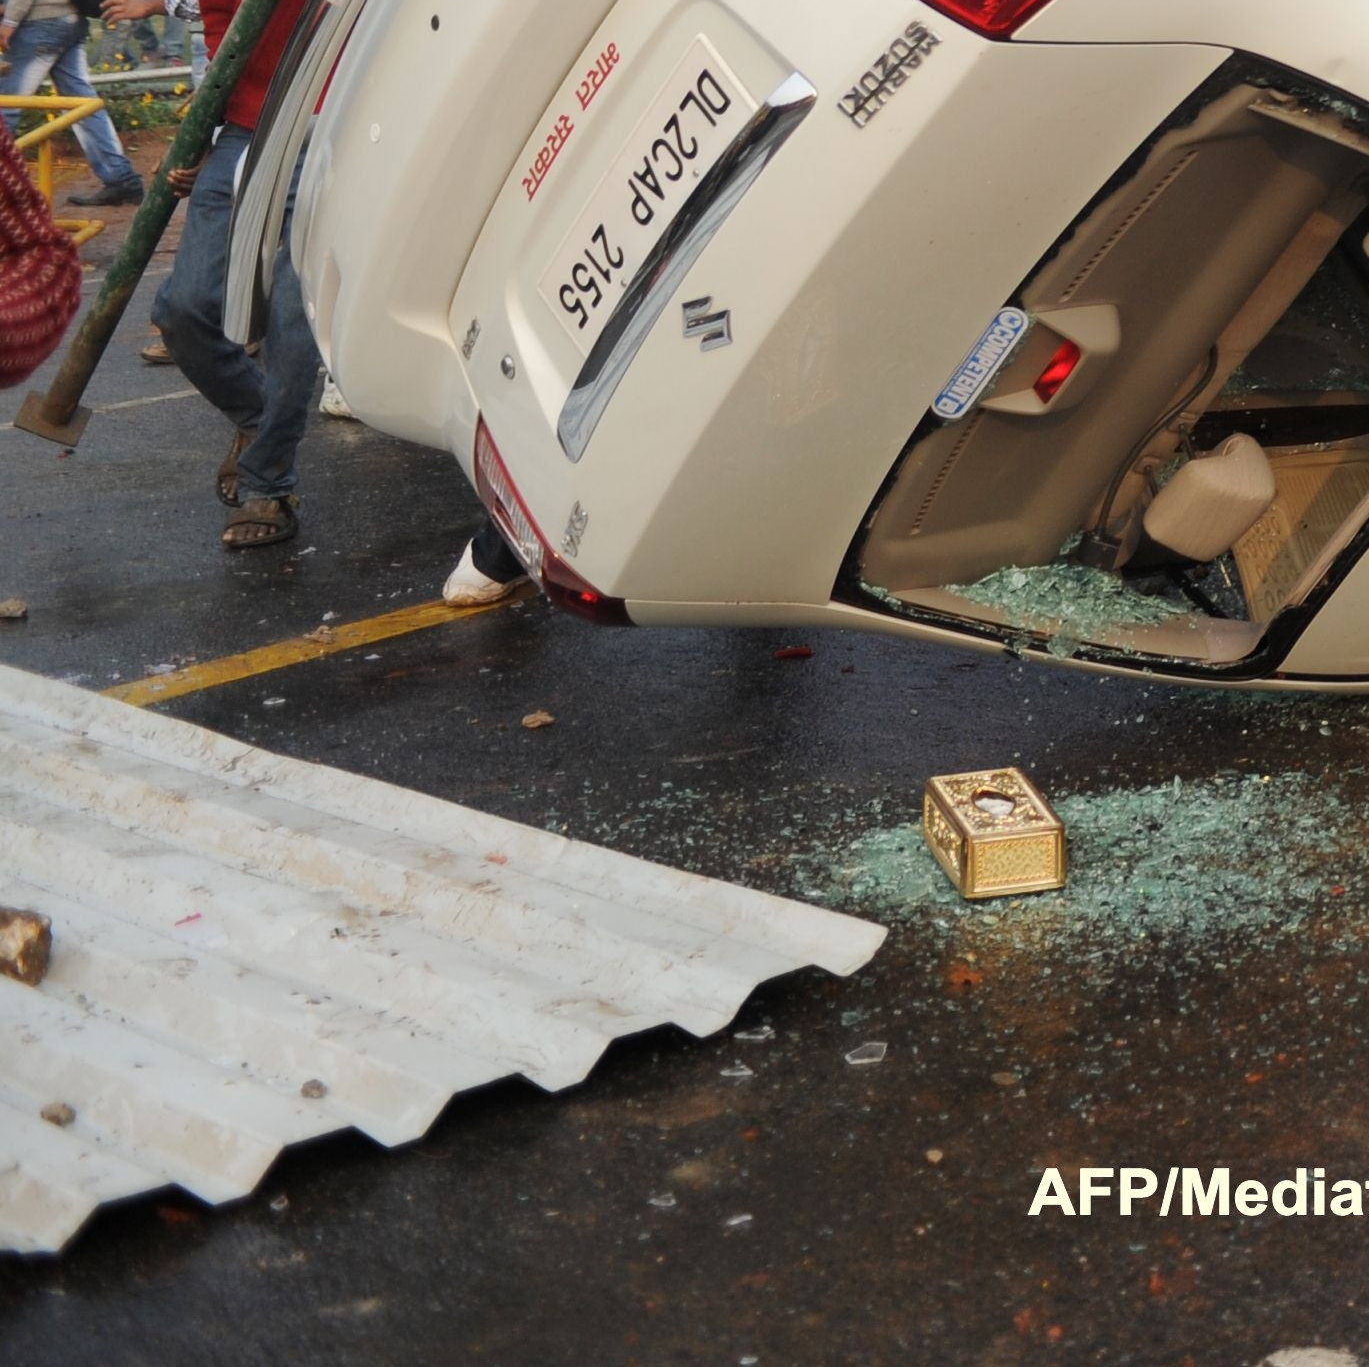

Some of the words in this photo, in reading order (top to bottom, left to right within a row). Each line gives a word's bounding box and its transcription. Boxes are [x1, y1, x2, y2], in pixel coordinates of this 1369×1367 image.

[575, 42, 620, 111] भारत
[836, 20, 928, 118] SUZUKI
[851, 30, 943, 129] MARUTI
[522, 114, 574, 202] सरकार
[627, 68, 732, 226] DL2CAP
[558, 223, 625, 330] 2155
[946, 324, 1016, 406] COMPETENT
